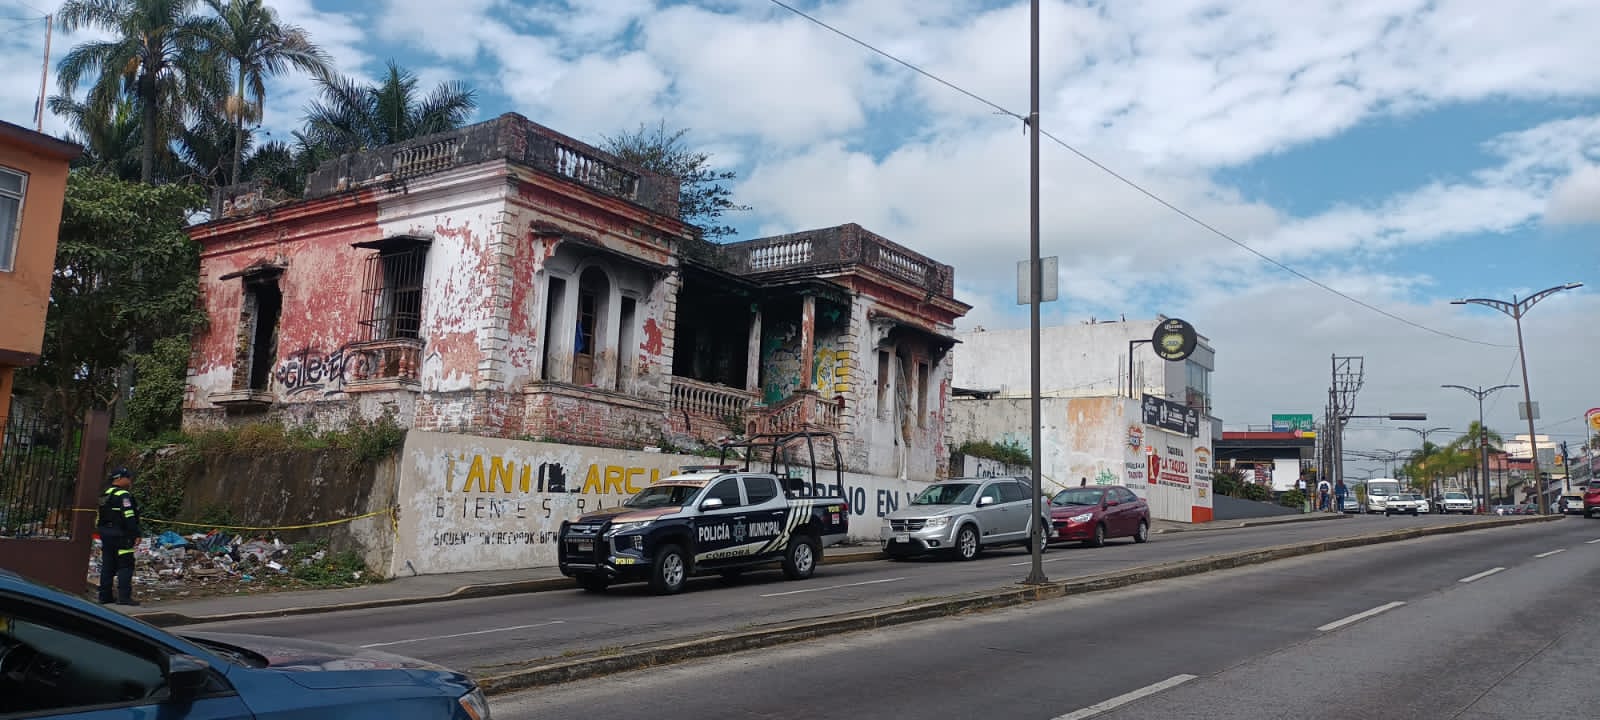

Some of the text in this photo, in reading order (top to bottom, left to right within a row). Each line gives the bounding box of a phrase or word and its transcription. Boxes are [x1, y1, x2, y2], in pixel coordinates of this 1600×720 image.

[1168, 458, 1188, 474] TAQUIZA
[876, 489, 899, 518] EN
[698, 520, 782, 543] POLICÍA MUNICIPAL
